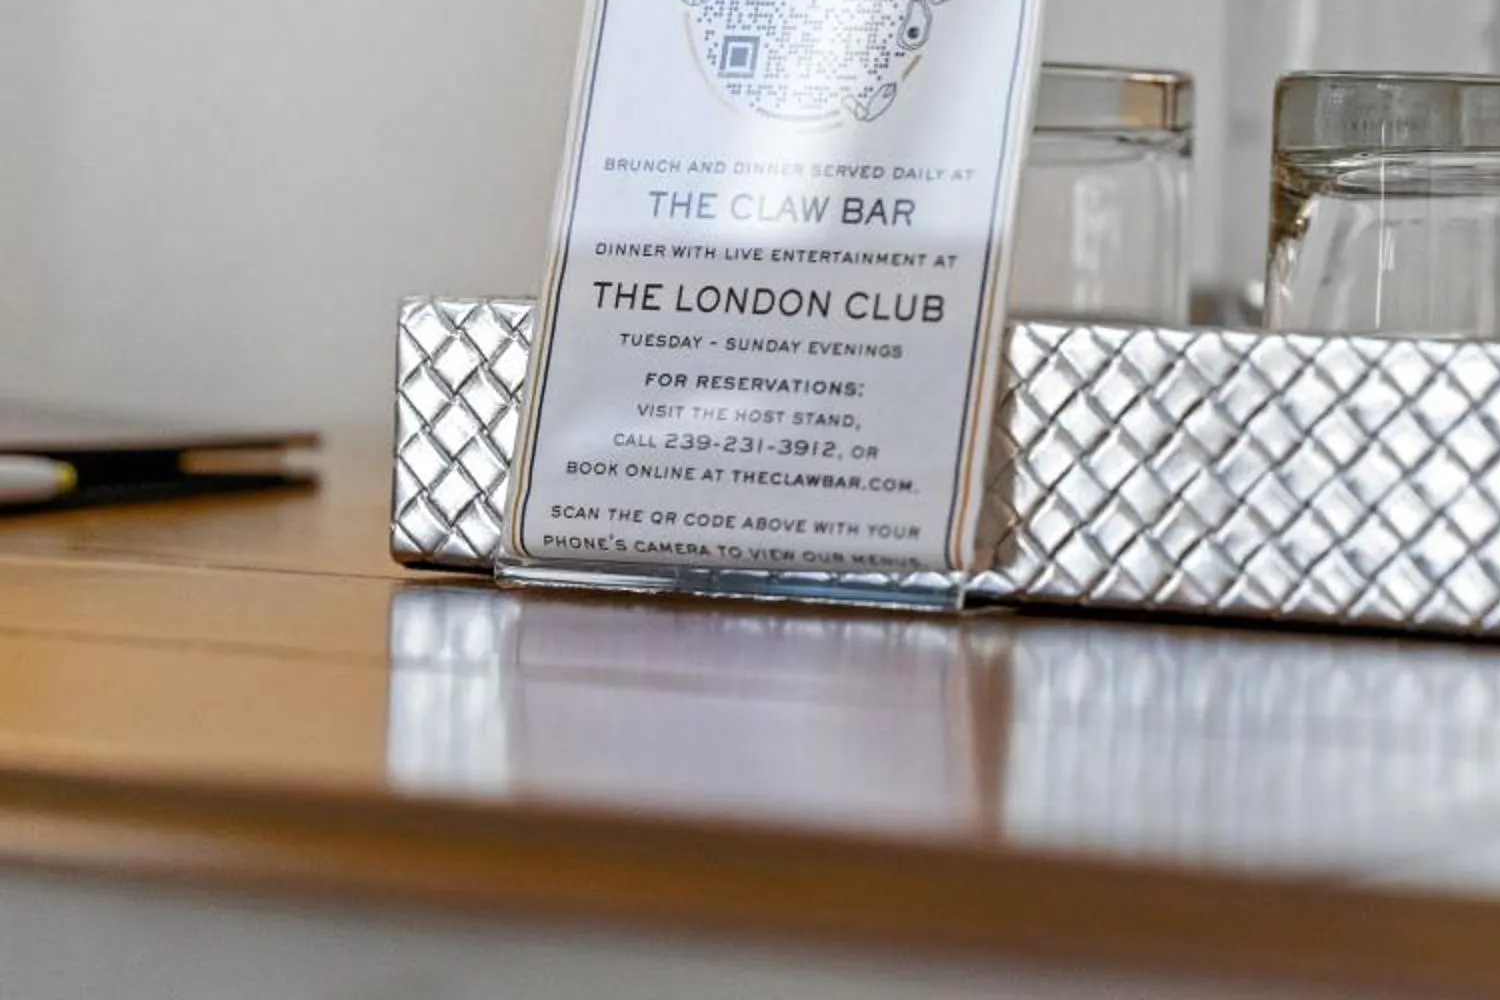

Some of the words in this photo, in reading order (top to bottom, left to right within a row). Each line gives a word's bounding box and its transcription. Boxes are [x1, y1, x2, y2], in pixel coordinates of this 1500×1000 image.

[604, 158, 681, 172] BRUNCH
[688, 161, 725, 174] AND
[734, 162, 805, 176] DINNER
[812, 165, 885, 179] SERVED
[893, 167, 946, 180] DAILY
[950, 169, 975, 181] AT
[649, 191, 718, 219] THE
[731, 193, 830, 223] CLAW
[841, 197, 916, 226] BAR
[596, 242, 666, 257] DINNER
[672, 246, 717, 259] WITH
[725, 248, 763, 261] LIVE
[772, 249, 927, 267] ENTERTAINMENT
[933, 255, 958, 268] AT
[593, 282, 663, 312] THE
[676, 285, 830, 317] LONDON
[846, 292, 945, 323] CLUB
[619, 332, 703, 350] TUESDAY
[725, 337, 801, 355] SUNDAY
[808, 341, 903, 359] EVENINGS
[644, 372, 687, 388] FOR
[696, 375, 864, 398] RESERVATIONS:
[637, 403, 682, 418] VISIT
[692, 405, 728, 421] THE
[735, 407, 785, 424] HOST
[792, 411, 862, 431] STAND,
[613, 432, 657, 448] CALL
[664, 433, 843, 460] 239-231-3912,
[851, 444, 879, 460] OR
[566, 461, 618, 476] BOOK
[626, 464, 695, 481] ONLINE
[701, 469, 725, 482] AT
[732, 470, 921, 494] THECLAWBAR.COM.
[551, 505, 600, 520] SCAN
[608, 508, 643, 523] THE
[650, 510, 677, 526] QR
[684, 512, 736, 529] CODE
[741, 517, 806, 533] ABOVE
[814, 521, 859, 537] WITH
[867, 523, 921, 540] YOUR
[543, 534, 627, 552] PHONE'S
[635, 540, 709, 555] CAMERA
[717, 544, 743, 559] TO
[749, 548, 795, 561] VIEW
[803, 550, 844, 563] OUR
